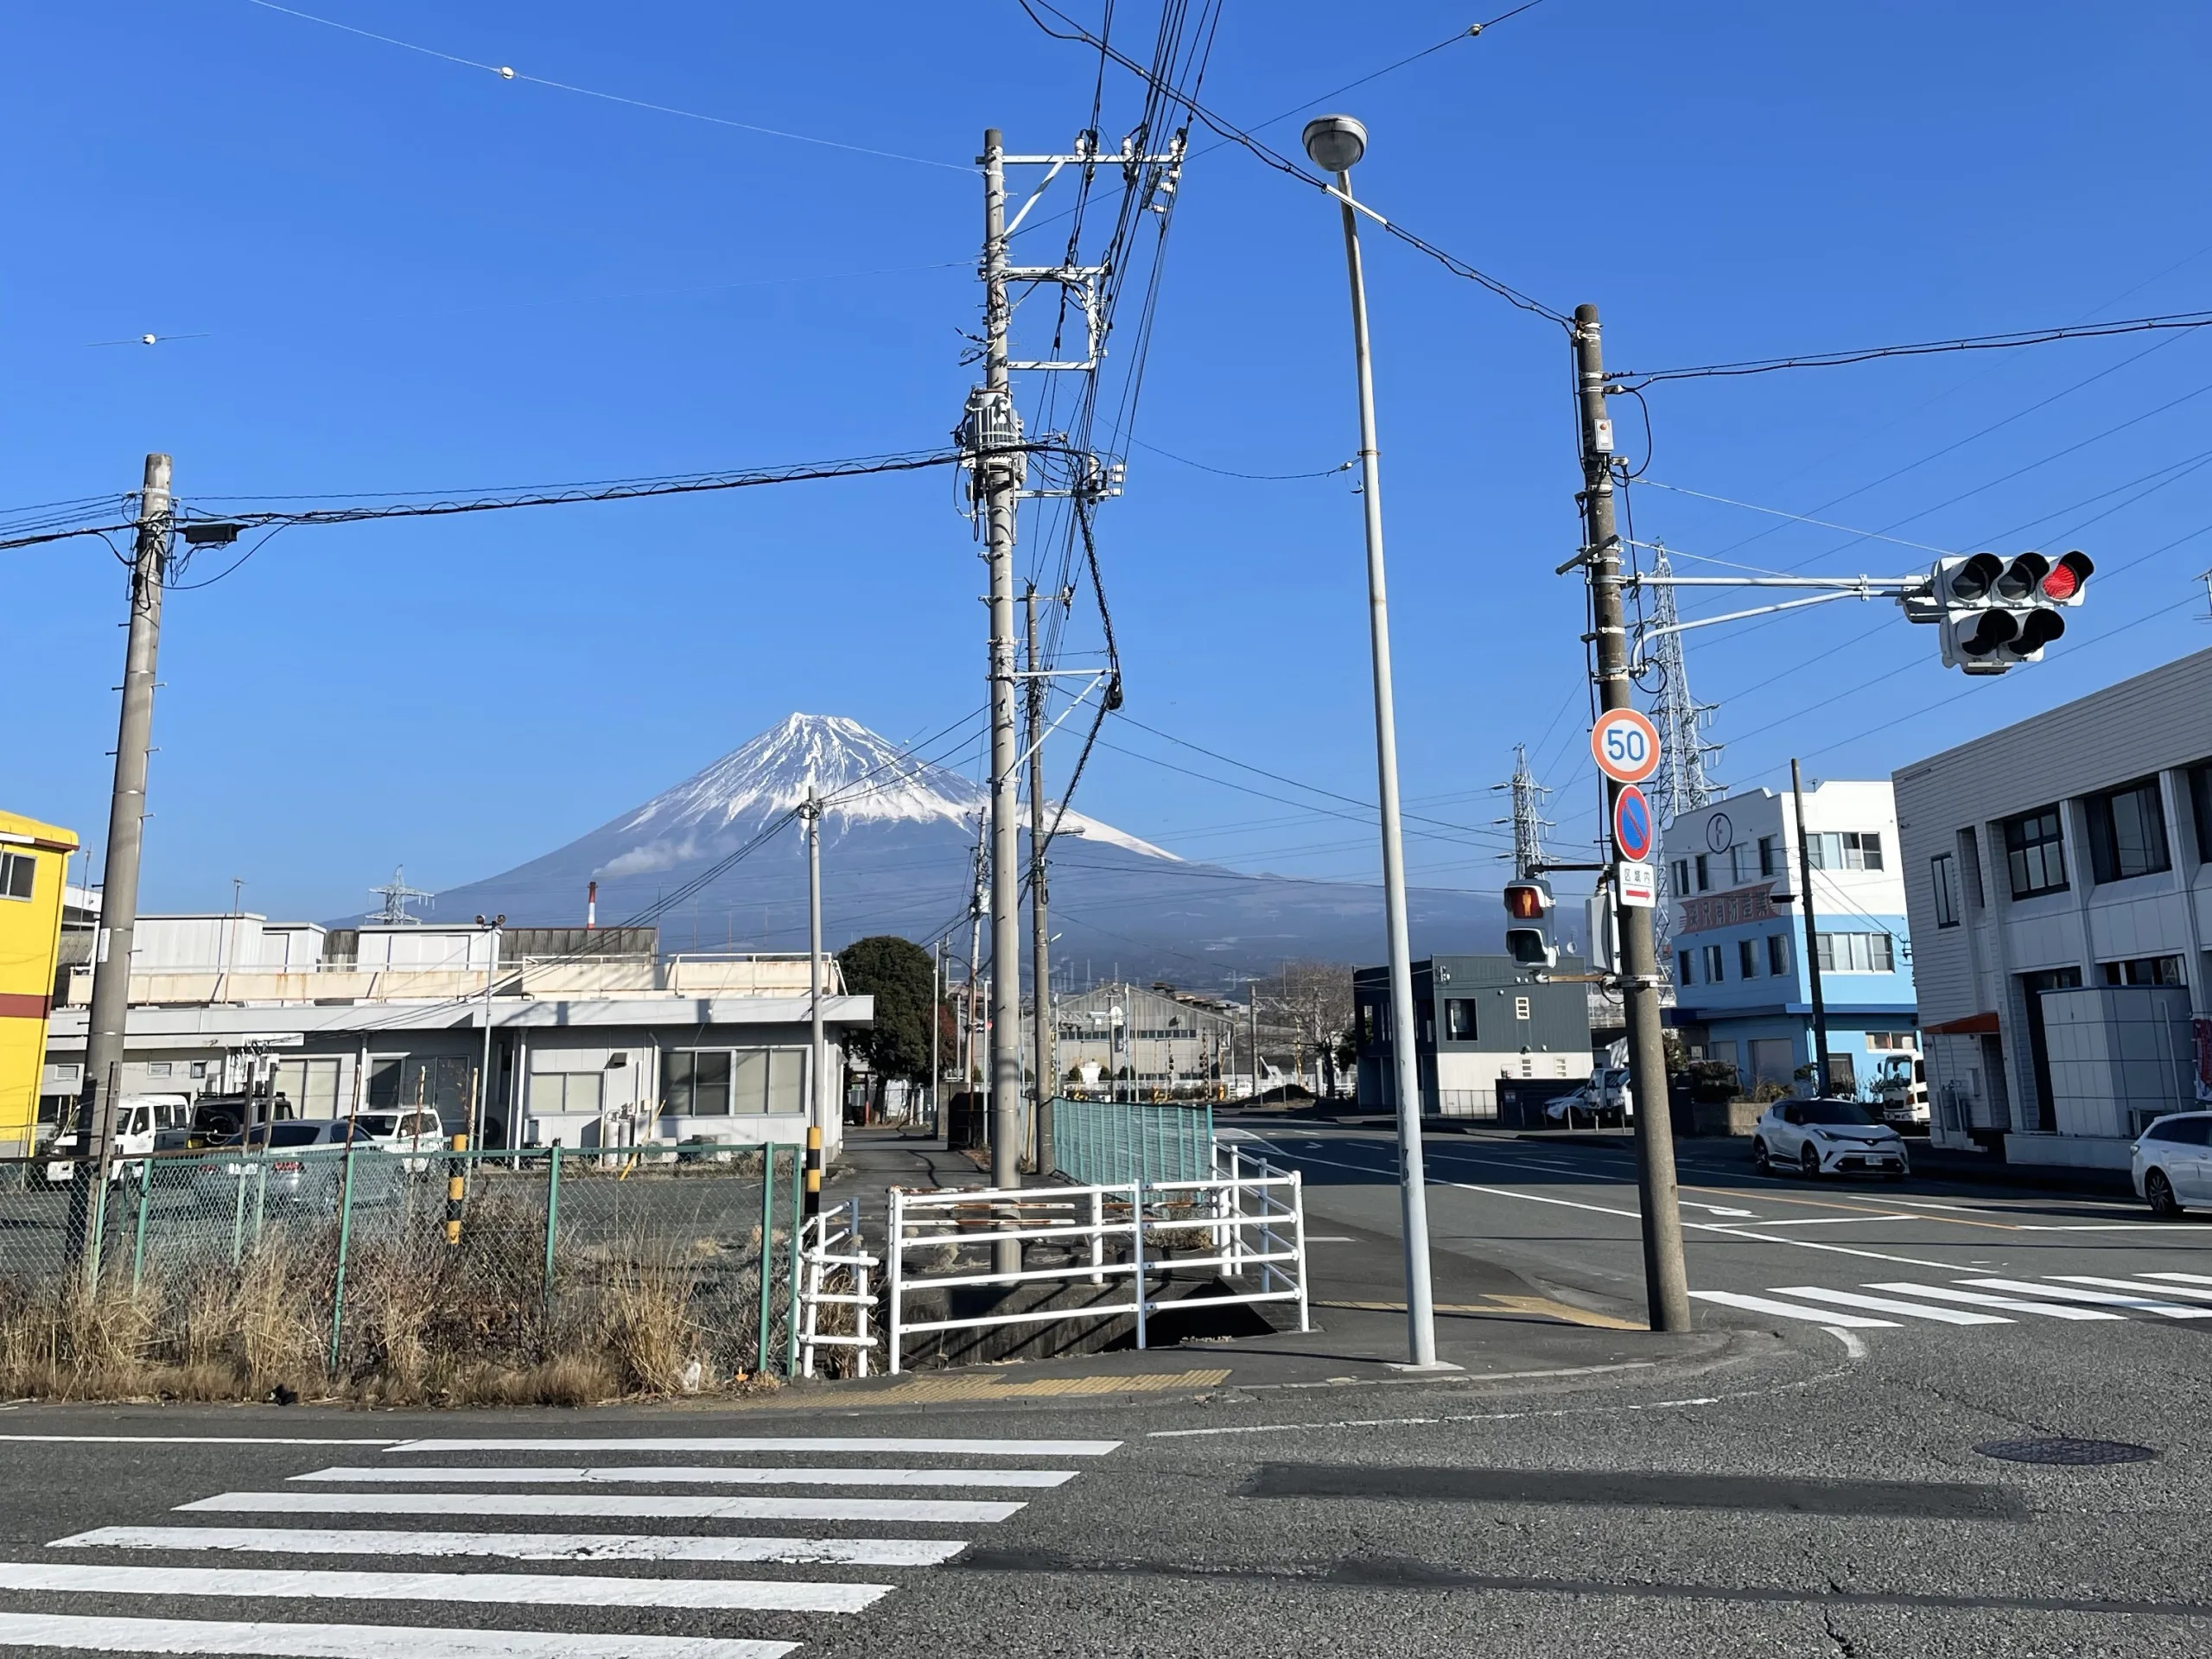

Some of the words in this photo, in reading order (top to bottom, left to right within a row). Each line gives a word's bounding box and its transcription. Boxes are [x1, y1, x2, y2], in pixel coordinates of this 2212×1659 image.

[1607, 729, 1644, 761] 50
[1624, 868, 1650, 884] 区域内
